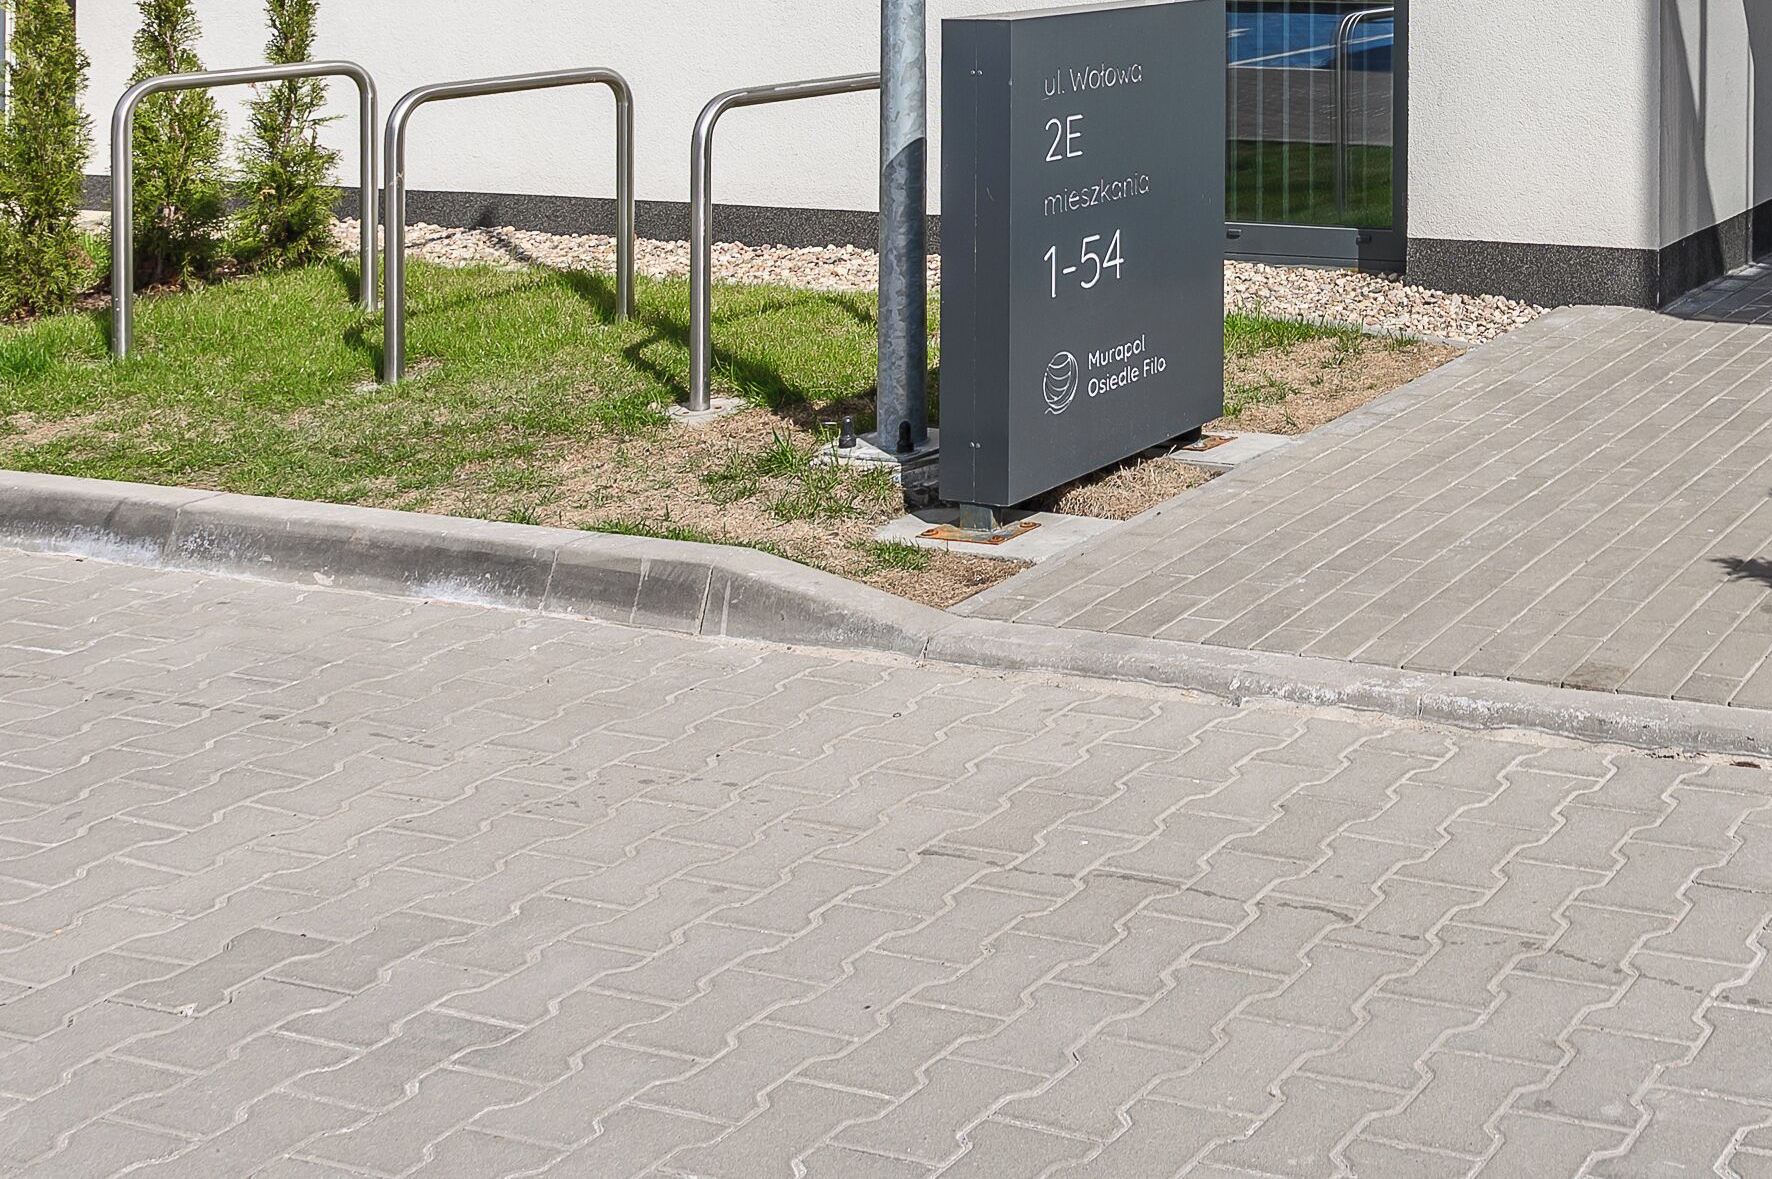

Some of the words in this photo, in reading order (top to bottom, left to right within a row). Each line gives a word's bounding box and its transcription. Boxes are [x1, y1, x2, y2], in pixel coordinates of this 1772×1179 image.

[1044, 68, 1065, 96] ul.
[1069, 62, 1143, 92] Wołowa
[1045, 113, 1084, 162] 2E
[1044, 172, 1150, 216] mieszkania
[1043, 228, 1125, 299] 1-54
[1088, 334, 1146, 370] Murapol
[1087, 365, 1139, 397] Osiedle
[1143, 356, 1166, 378] Filo
